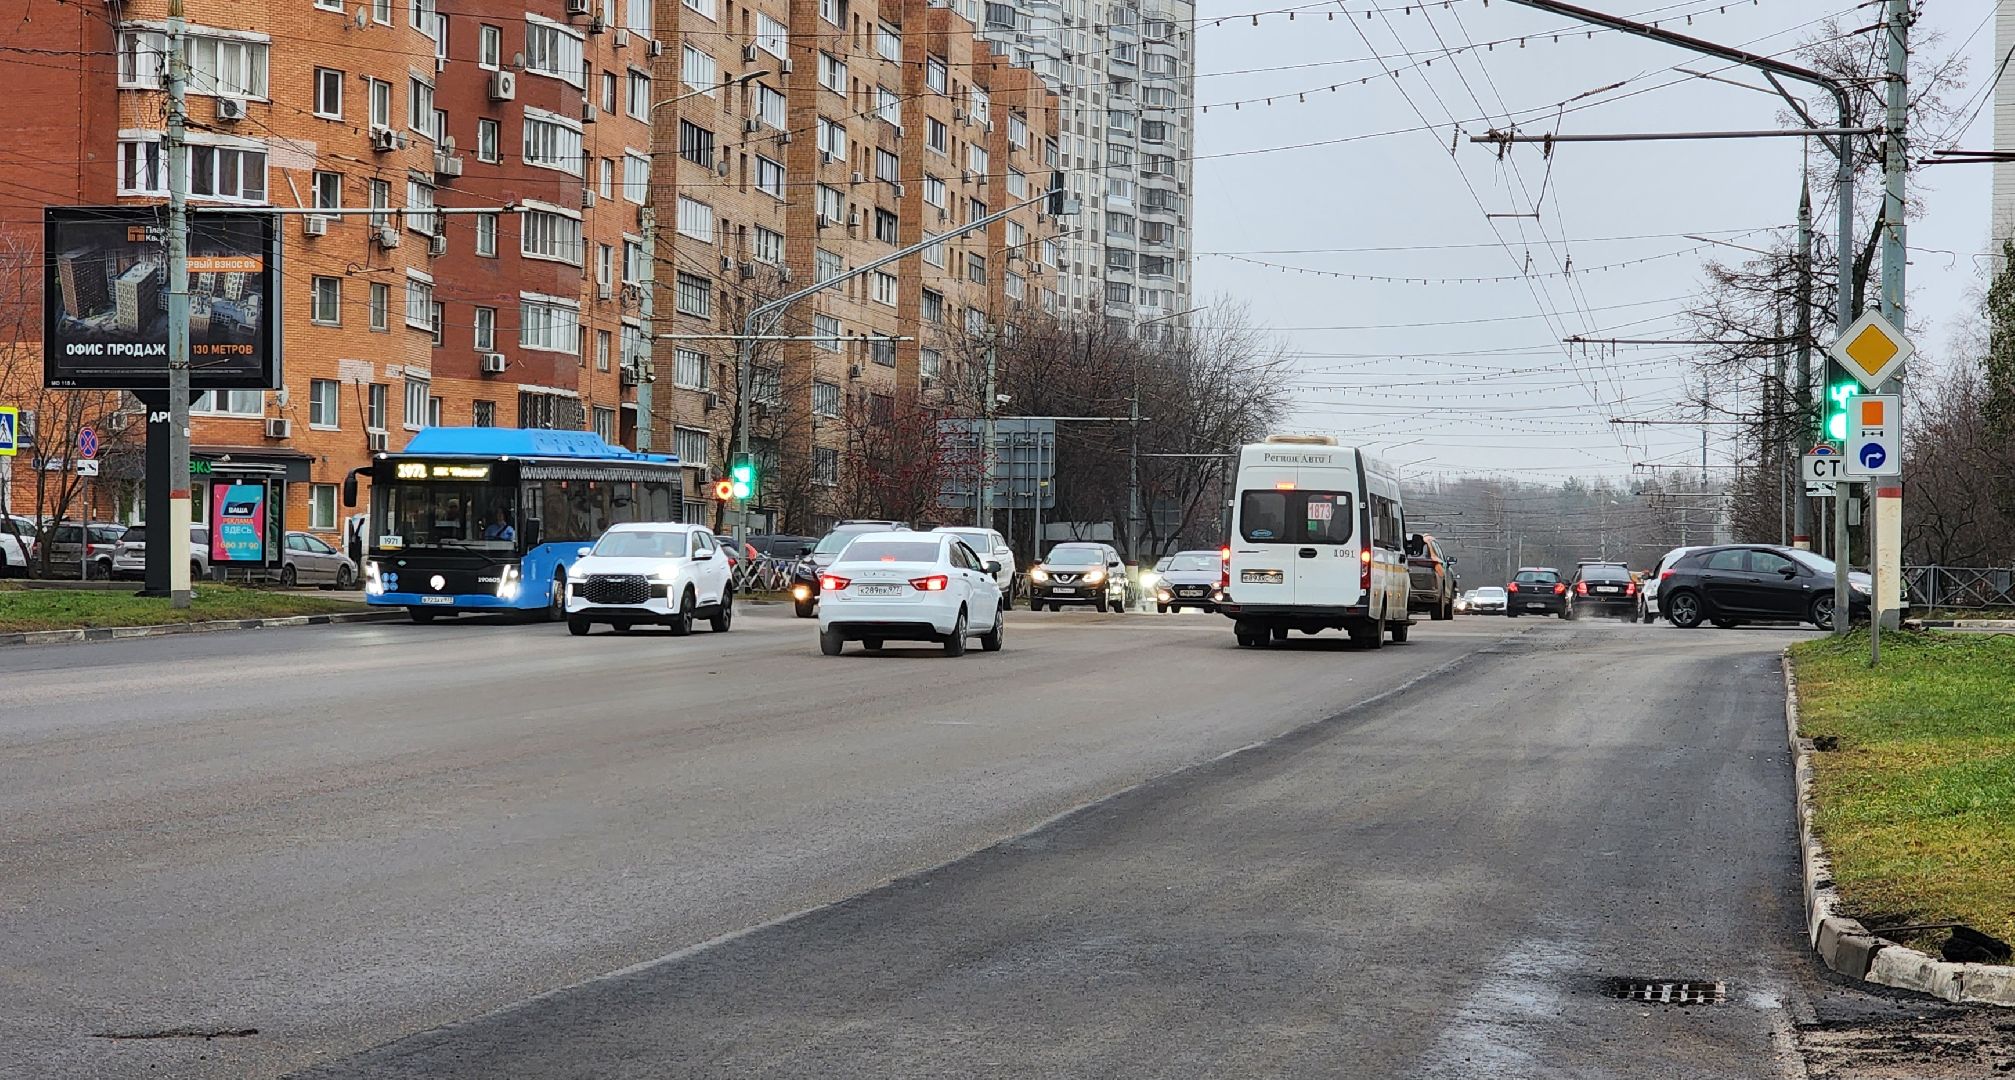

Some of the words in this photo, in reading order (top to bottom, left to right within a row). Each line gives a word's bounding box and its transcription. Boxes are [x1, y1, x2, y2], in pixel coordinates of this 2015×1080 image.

[214, 260, 243, 269] ВЗНОС
[66, 344, 104, 356] ОФИС
[107, 344, 166, 358] ПРОДАЖ
[192, 344, 209, 355] 130
[211, 344, 254, 355] МЕТРОВ
[1264, 453, 1299, 463] Регион
[1300, 454, 1325, 463] Авто
[1308, 503, 1331, 519] 1873
[224, 526, 252, 535] ЗДЕСЬ
[384, 536, 399, 545] 1971
[1333, 549, 1355, 559] 1091
